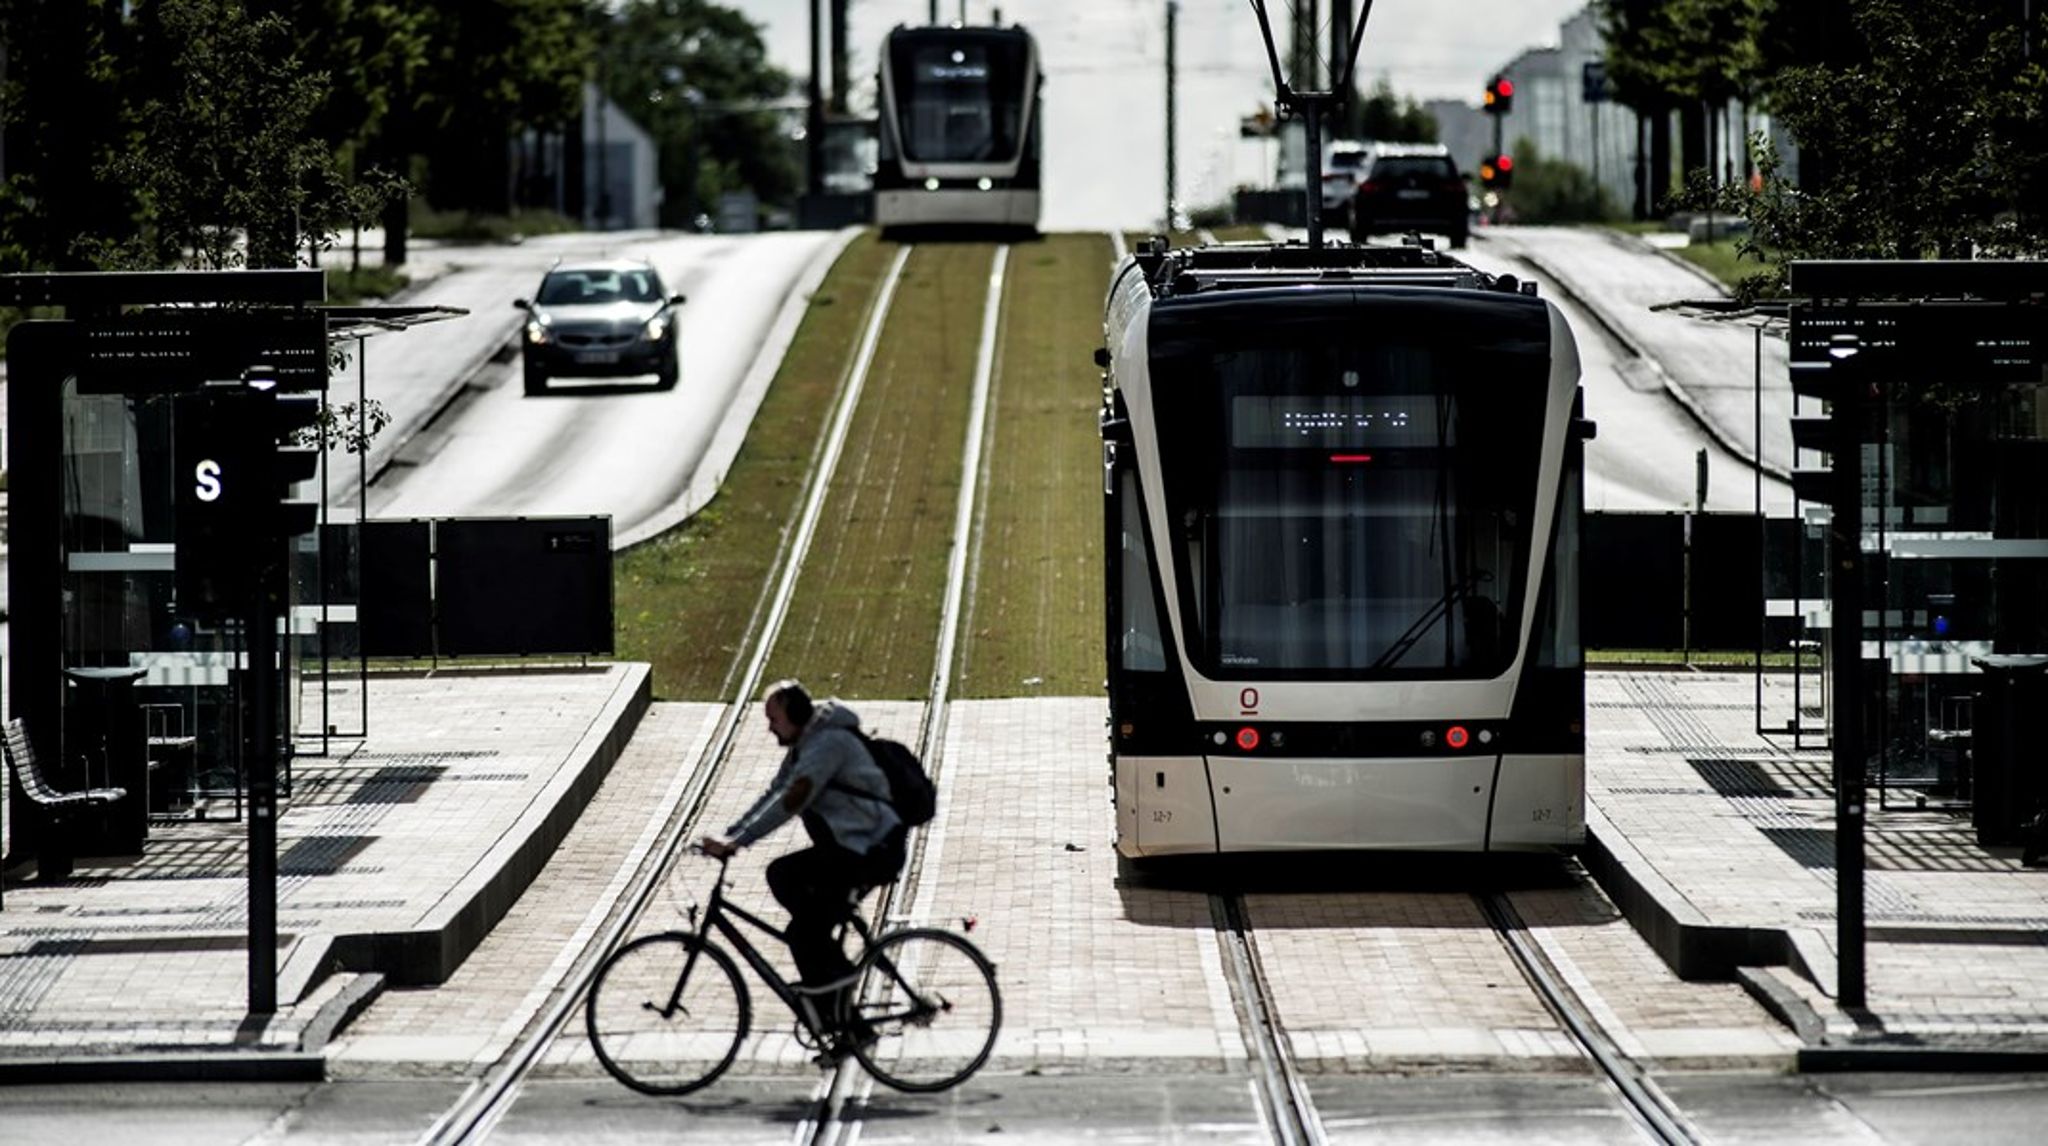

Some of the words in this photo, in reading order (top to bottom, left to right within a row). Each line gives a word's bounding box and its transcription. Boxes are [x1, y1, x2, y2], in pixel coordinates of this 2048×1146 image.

[195, 459, 221, 502] S
[1153, 810, 1172, 823] 12-7
[1532, 809, 1551, 821] 12-7
